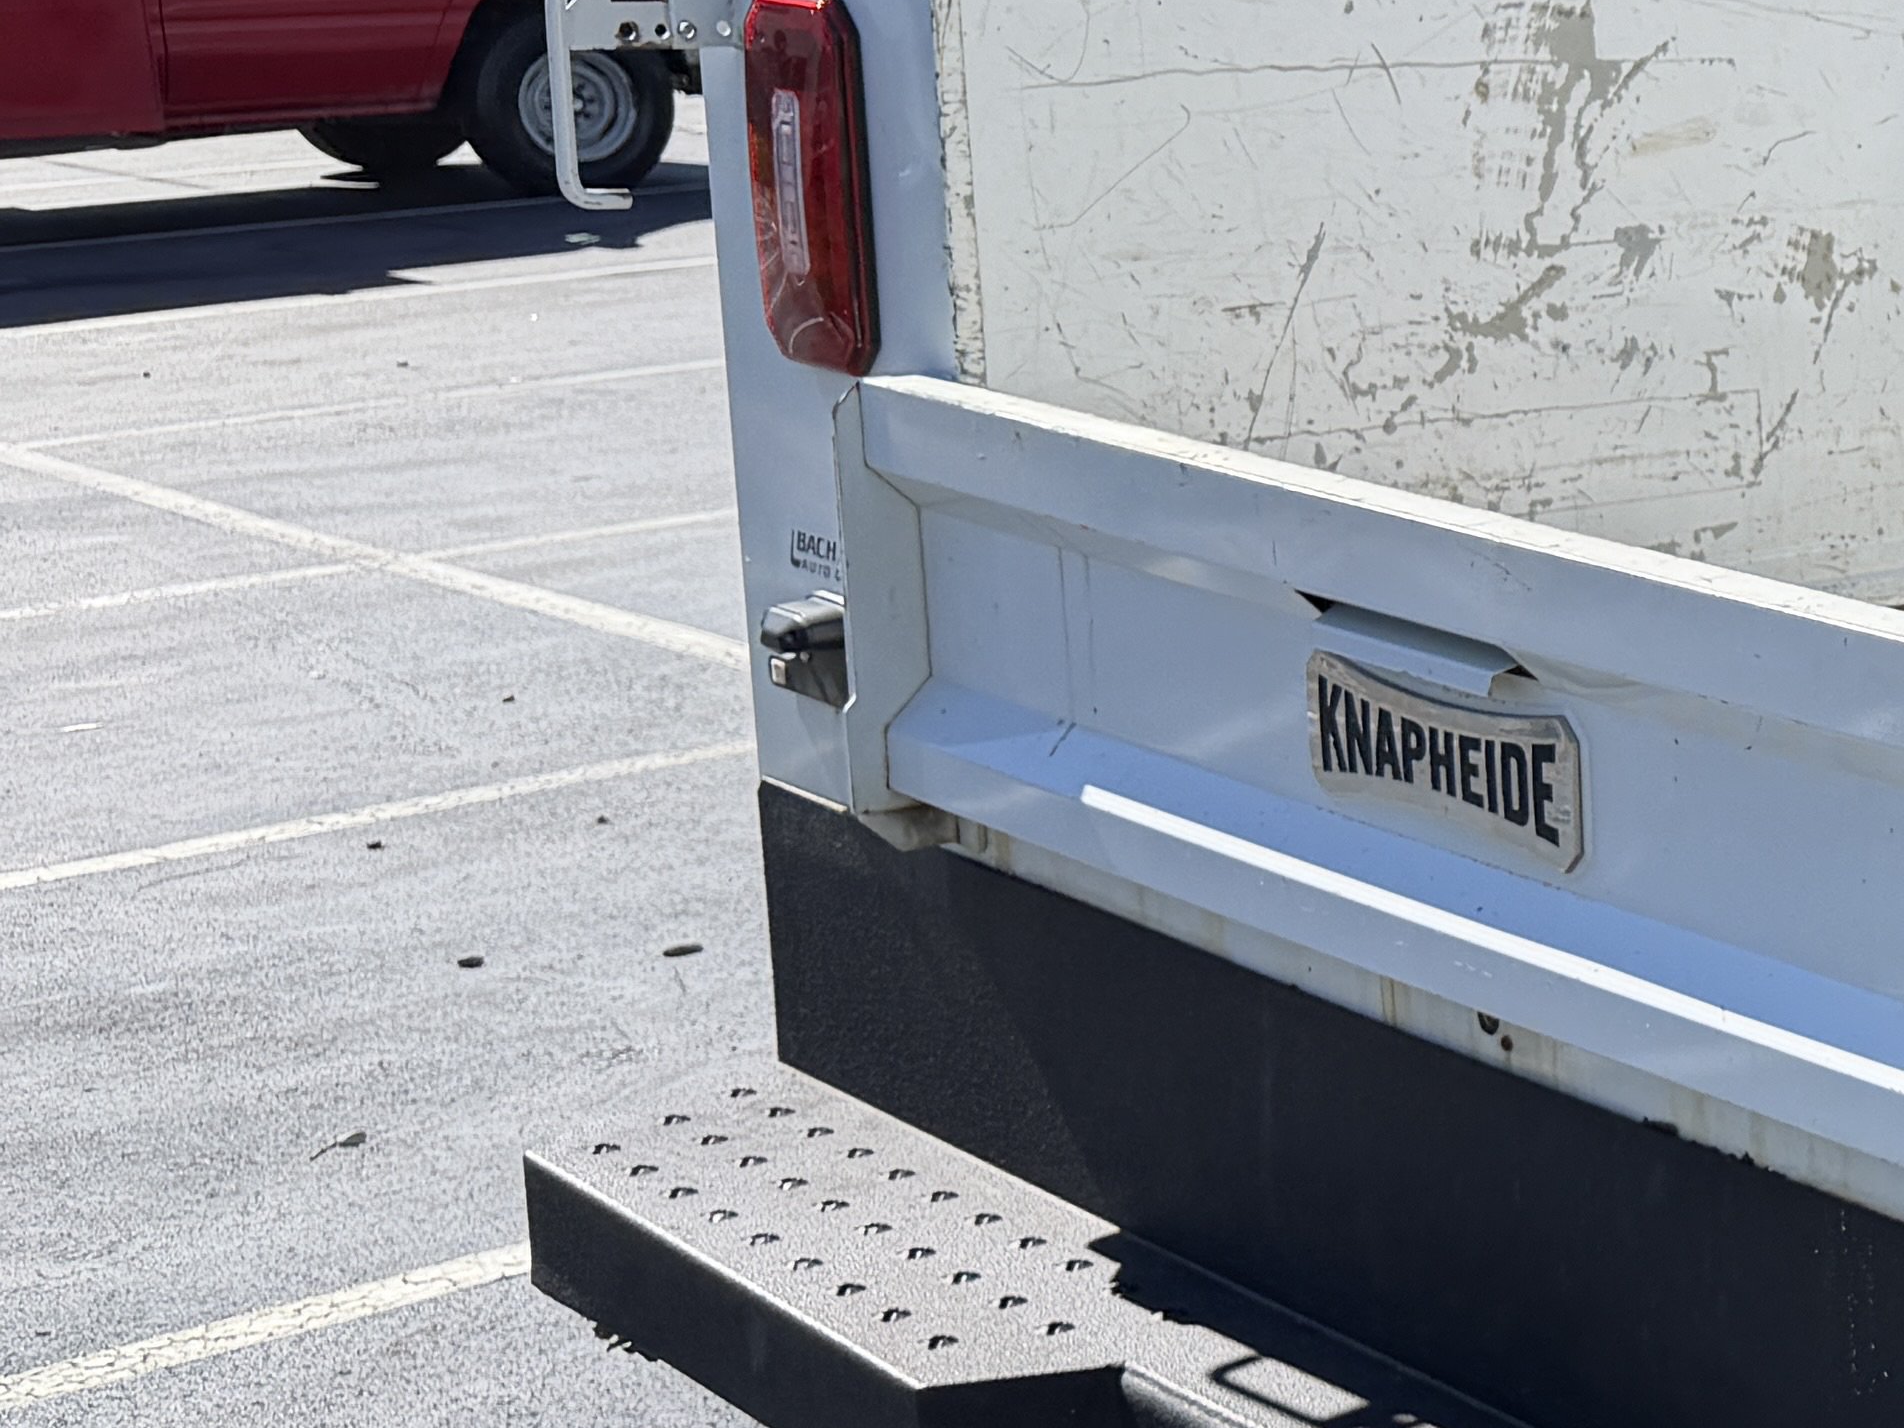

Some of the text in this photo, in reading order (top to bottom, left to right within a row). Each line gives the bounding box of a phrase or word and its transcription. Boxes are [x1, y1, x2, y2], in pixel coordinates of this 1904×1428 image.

[797, 529, 837, 562] BACH
[801, 558, 831, 579] AUTO
[1317, 673, 1561, 848] KNAPHEIDE
